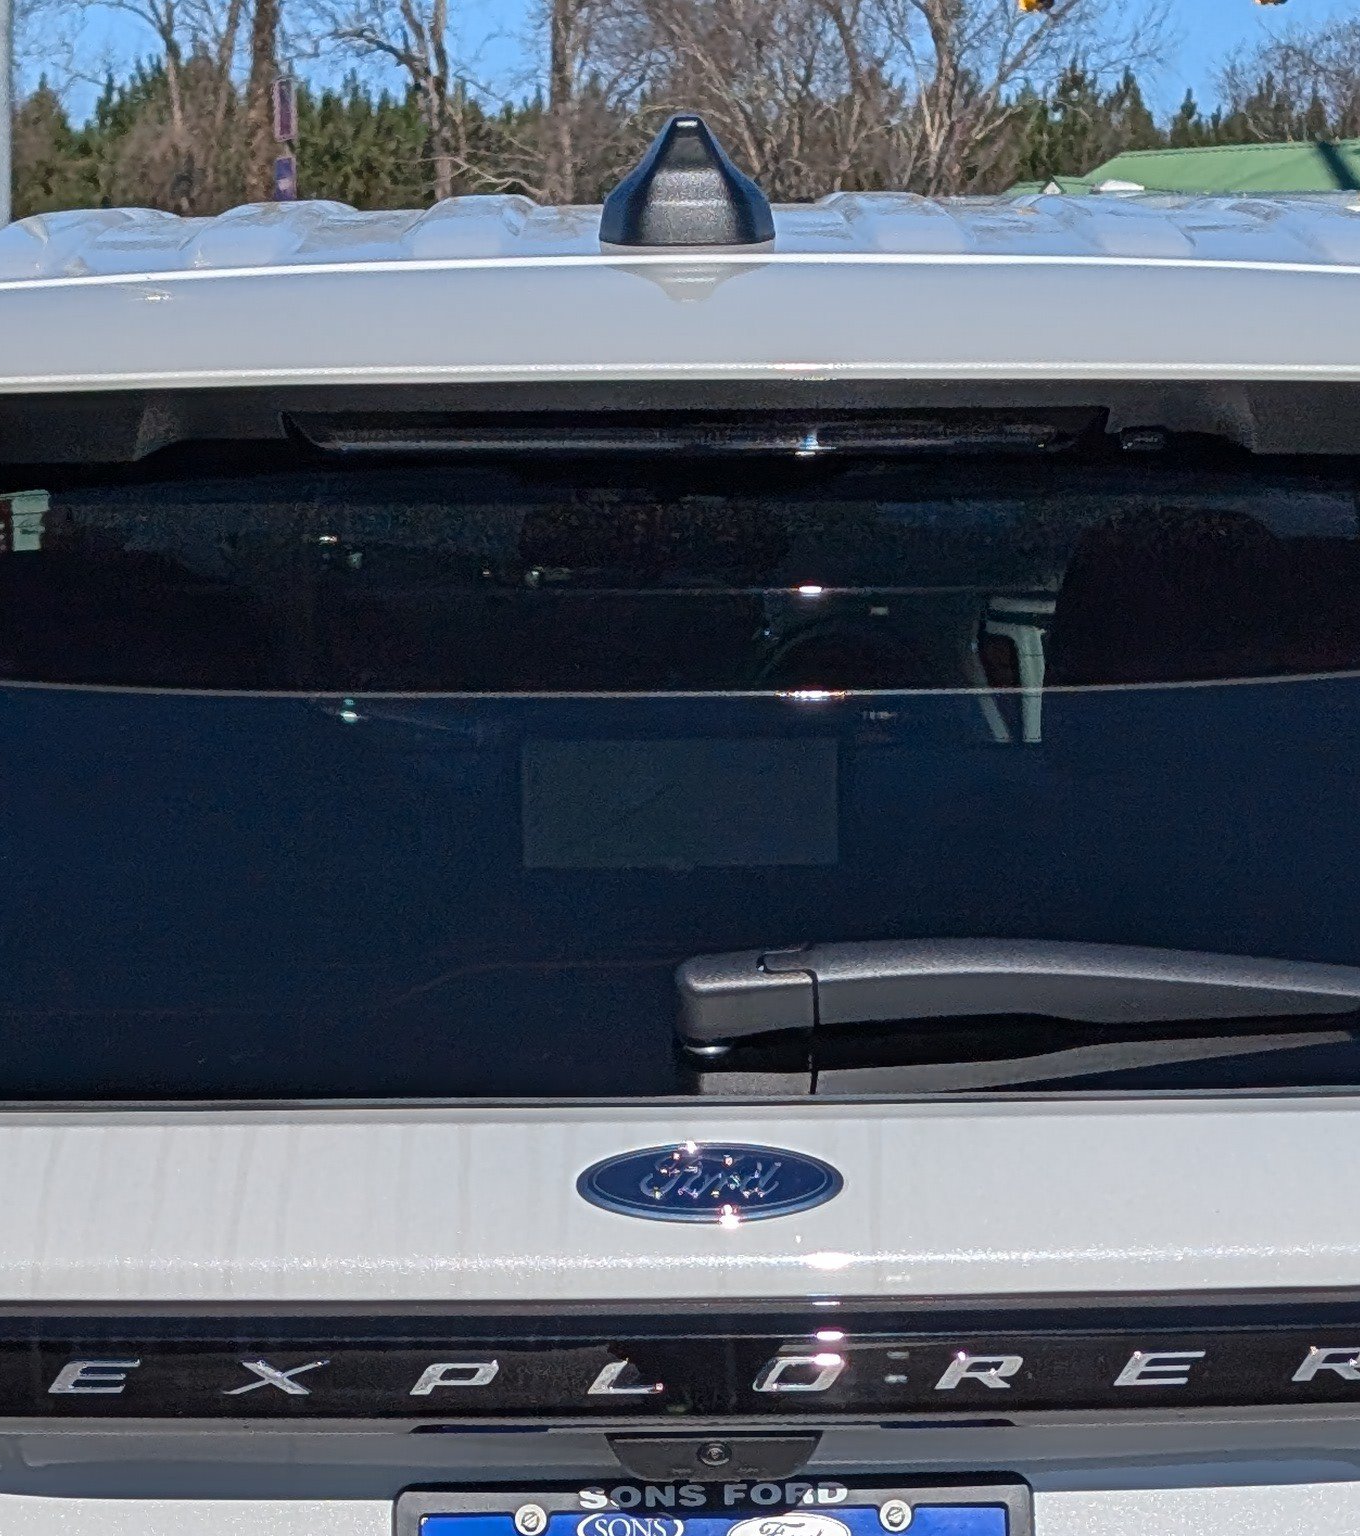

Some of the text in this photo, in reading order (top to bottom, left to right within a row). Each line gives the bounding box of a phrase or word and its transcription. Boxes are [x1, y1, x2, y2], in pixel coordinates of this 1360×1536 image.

[639, 1153, 782, 1201] Ford
[578, 1480, 848, 1510] SONS FORD
